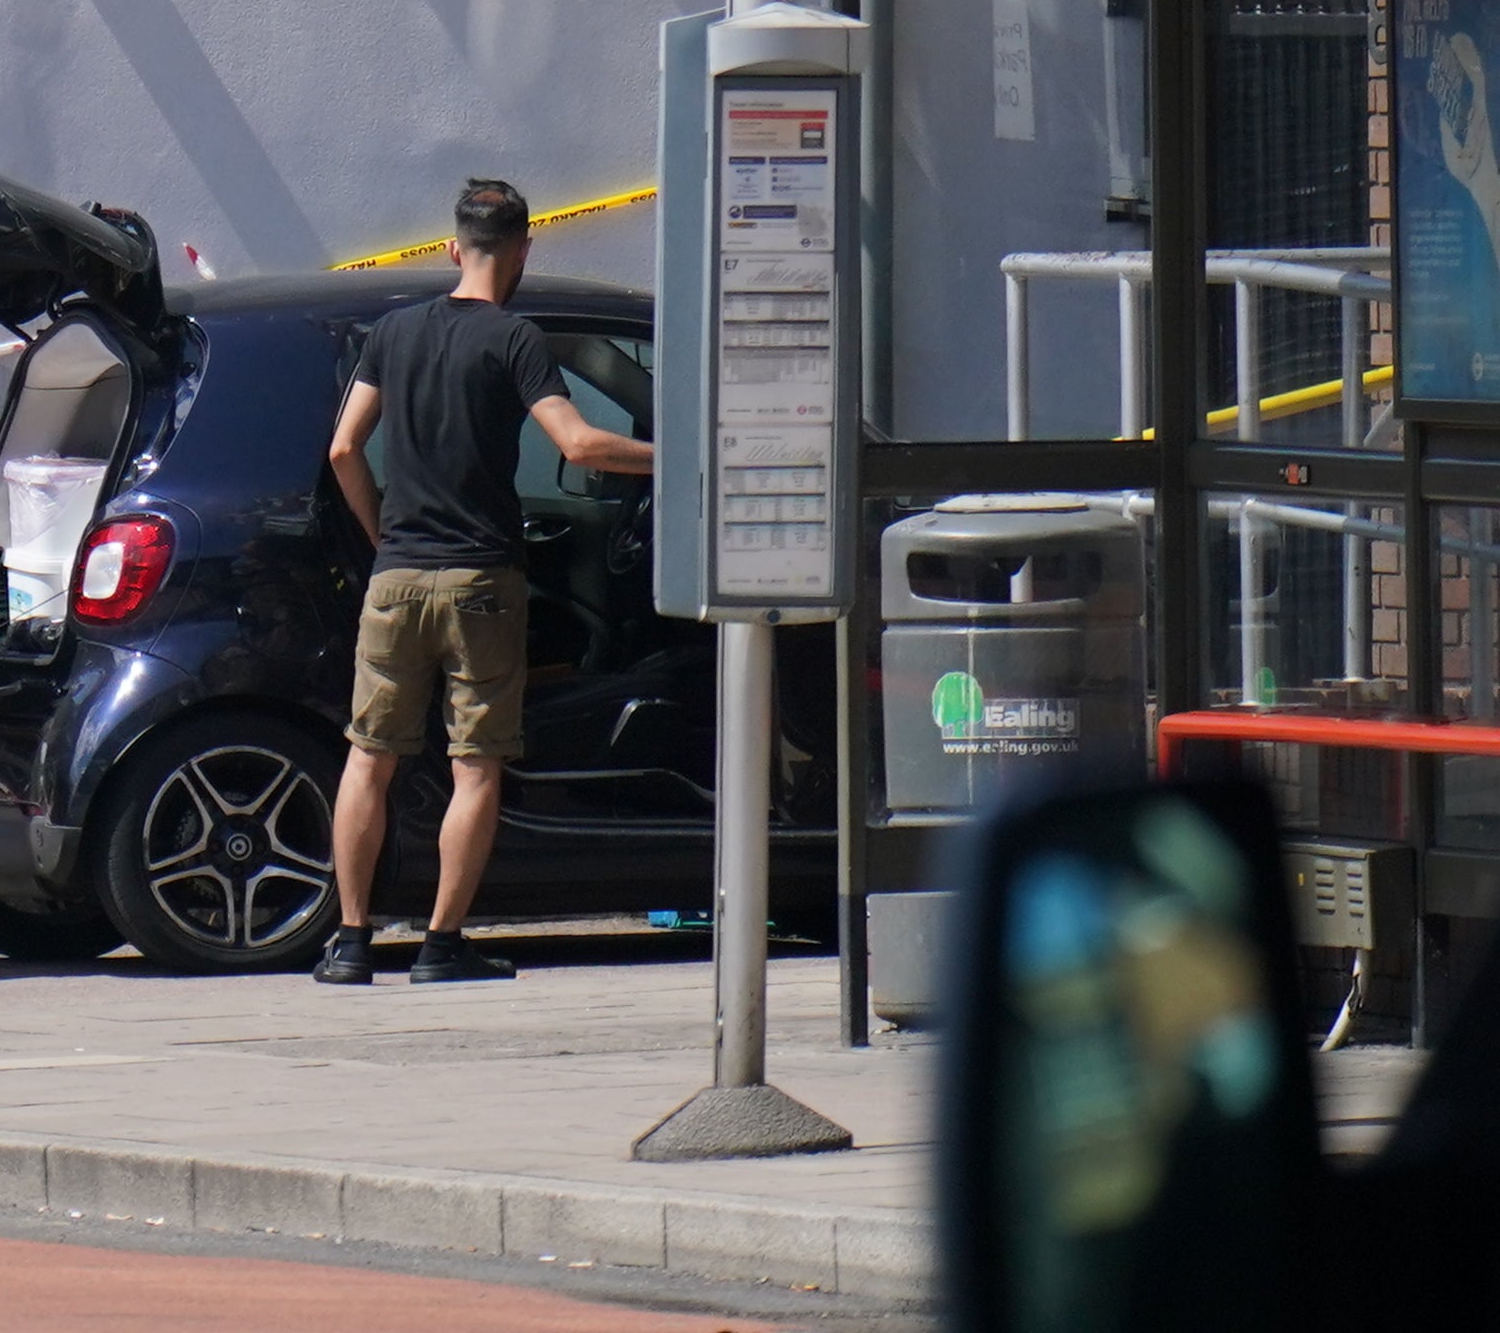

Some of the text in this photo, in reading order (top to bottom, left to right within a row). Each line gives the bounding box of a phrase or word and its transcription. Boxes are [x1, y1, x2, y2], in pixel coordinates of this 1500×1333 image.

[724, 259, 738, 271] E7
[724, 436, 737, 448] E8
[985, 704, 1074, 732] Ealing
